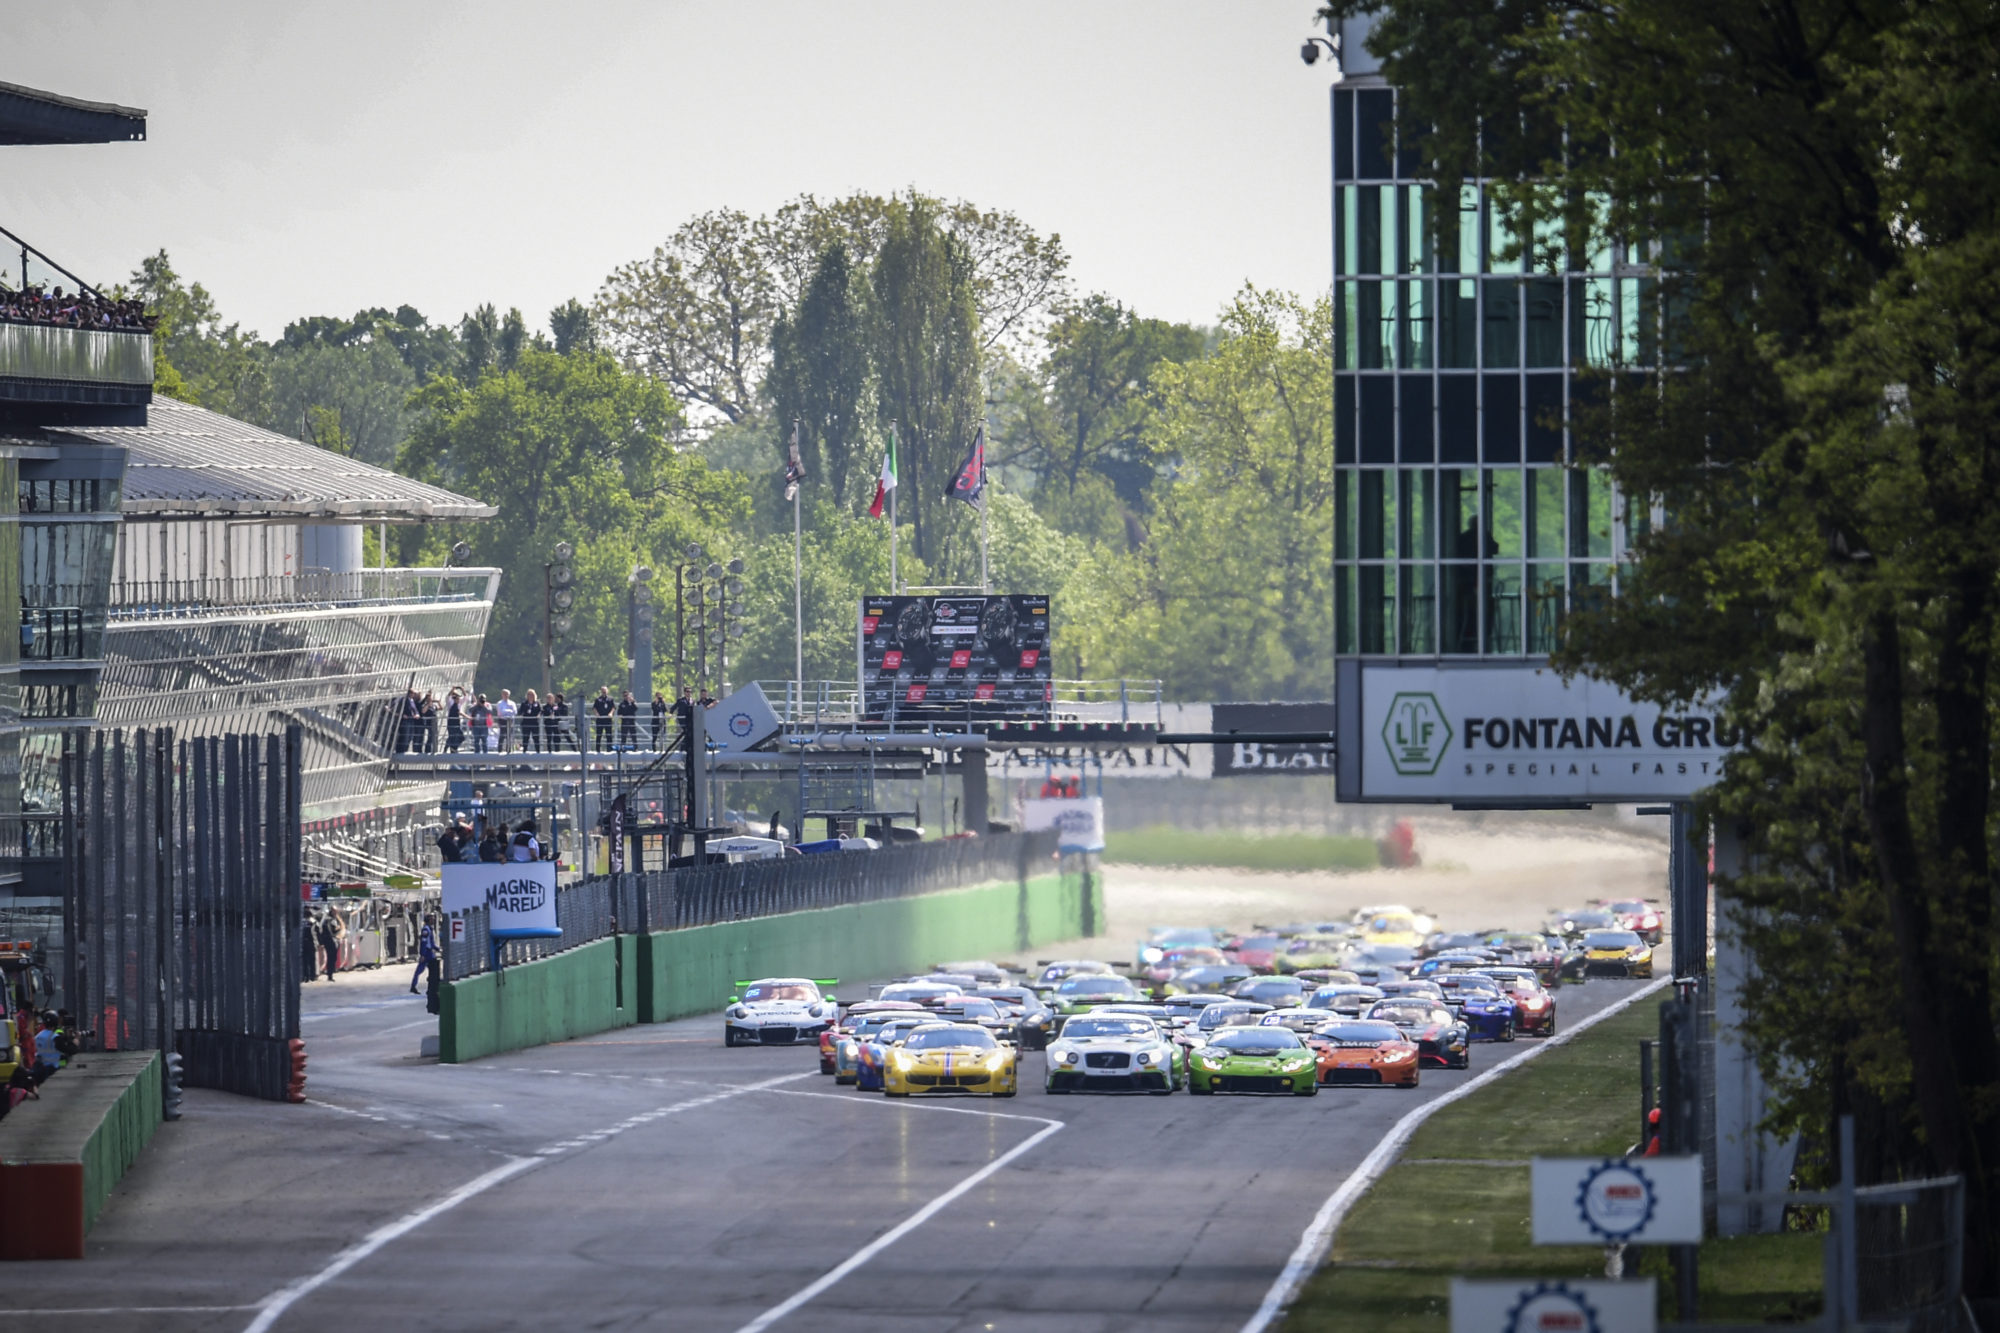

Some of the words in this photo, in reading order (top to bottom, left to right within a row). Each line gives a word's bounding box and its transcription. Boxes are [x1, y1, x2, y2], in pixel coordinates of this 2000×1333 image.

[1464, 717, 1641, 749] FONTANA
[1464, 762, 1600, 775] SPECIAL
[1632, 762, 1724, 775] FAST
[451, 920, 464, 939] F
